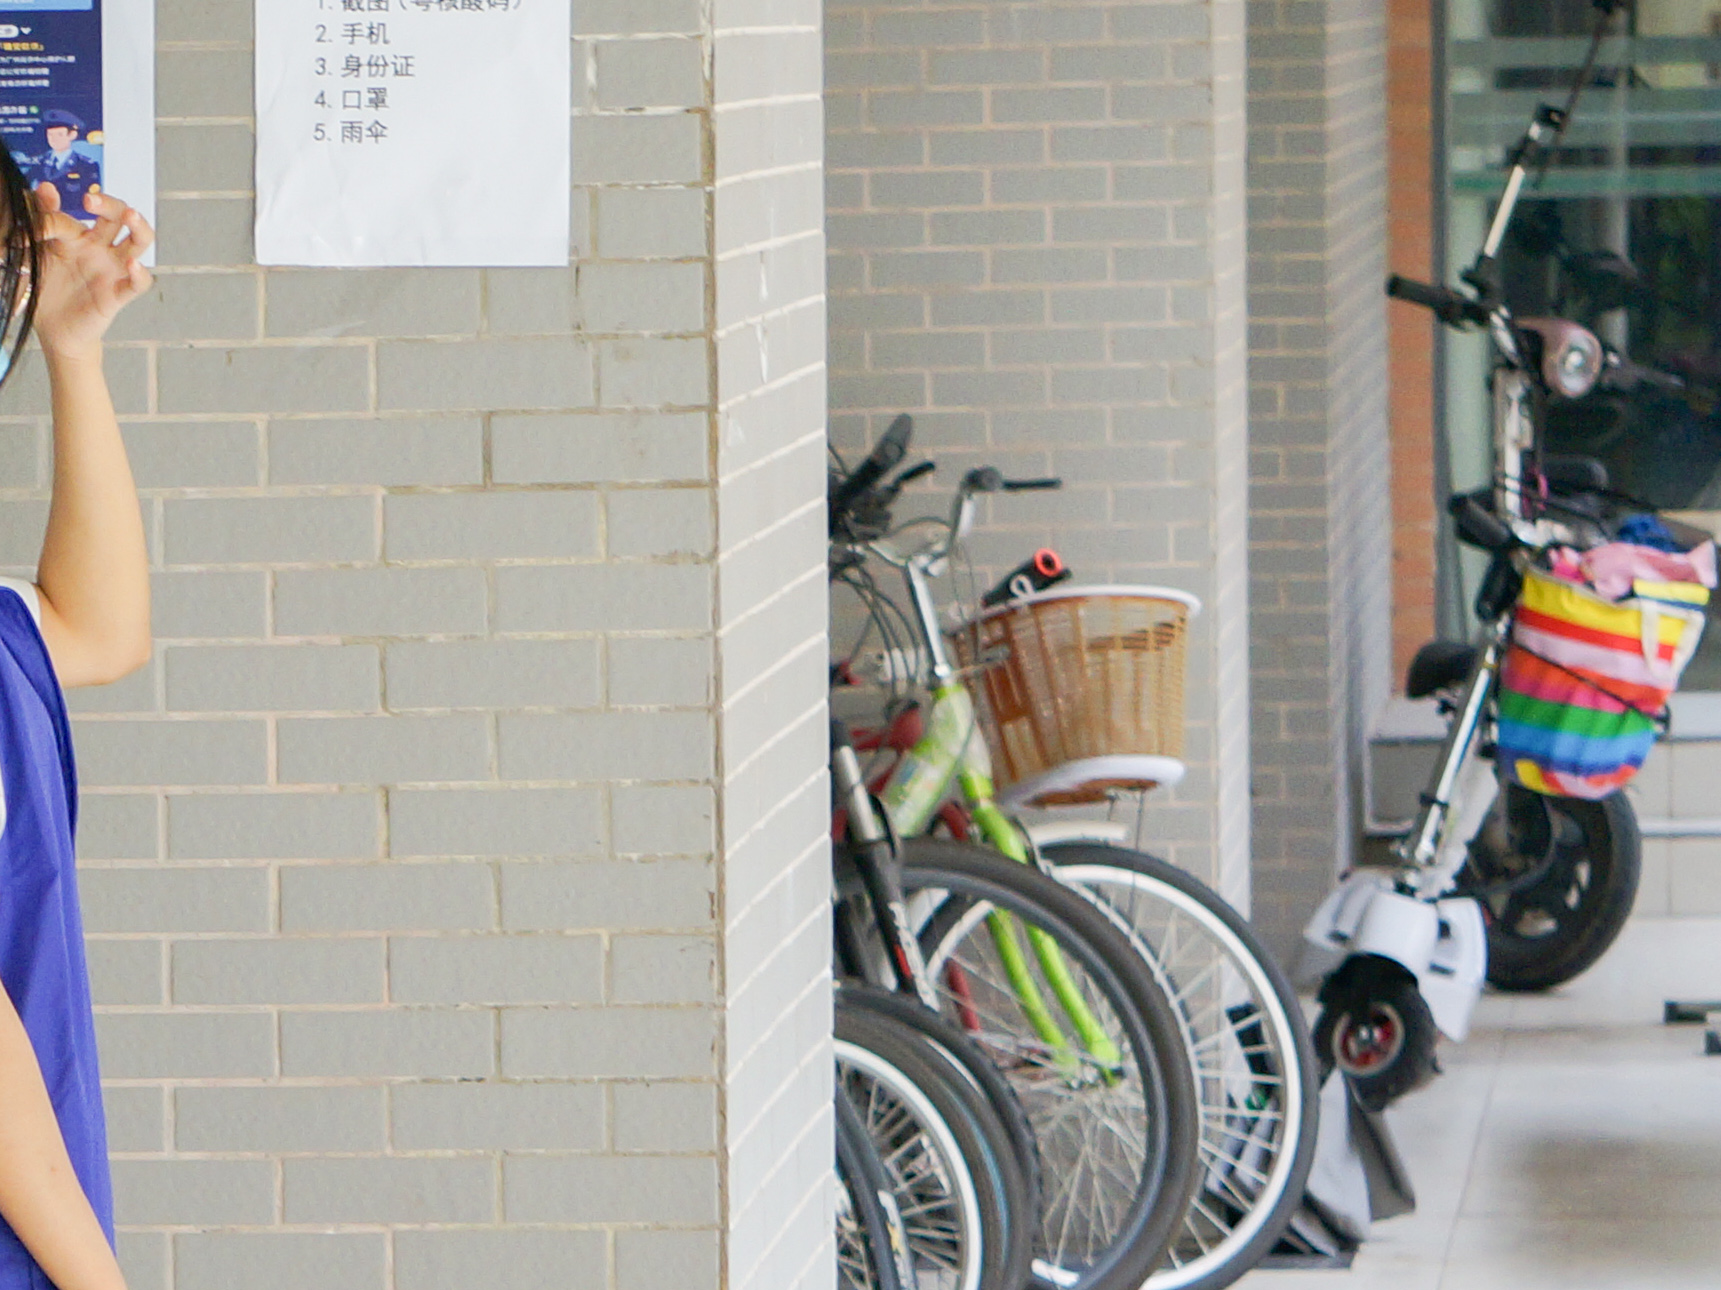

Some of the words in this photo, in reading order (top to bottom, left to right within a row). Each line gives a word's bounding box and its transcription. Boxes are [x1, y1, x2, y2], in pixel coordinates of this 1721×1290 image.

[341, 22, 390, 45] 手机
[341, 54, 415, 78] 身份证
[342, 87, 389, 111] 口罩
[340, 119, 388, 144] 雨伞
